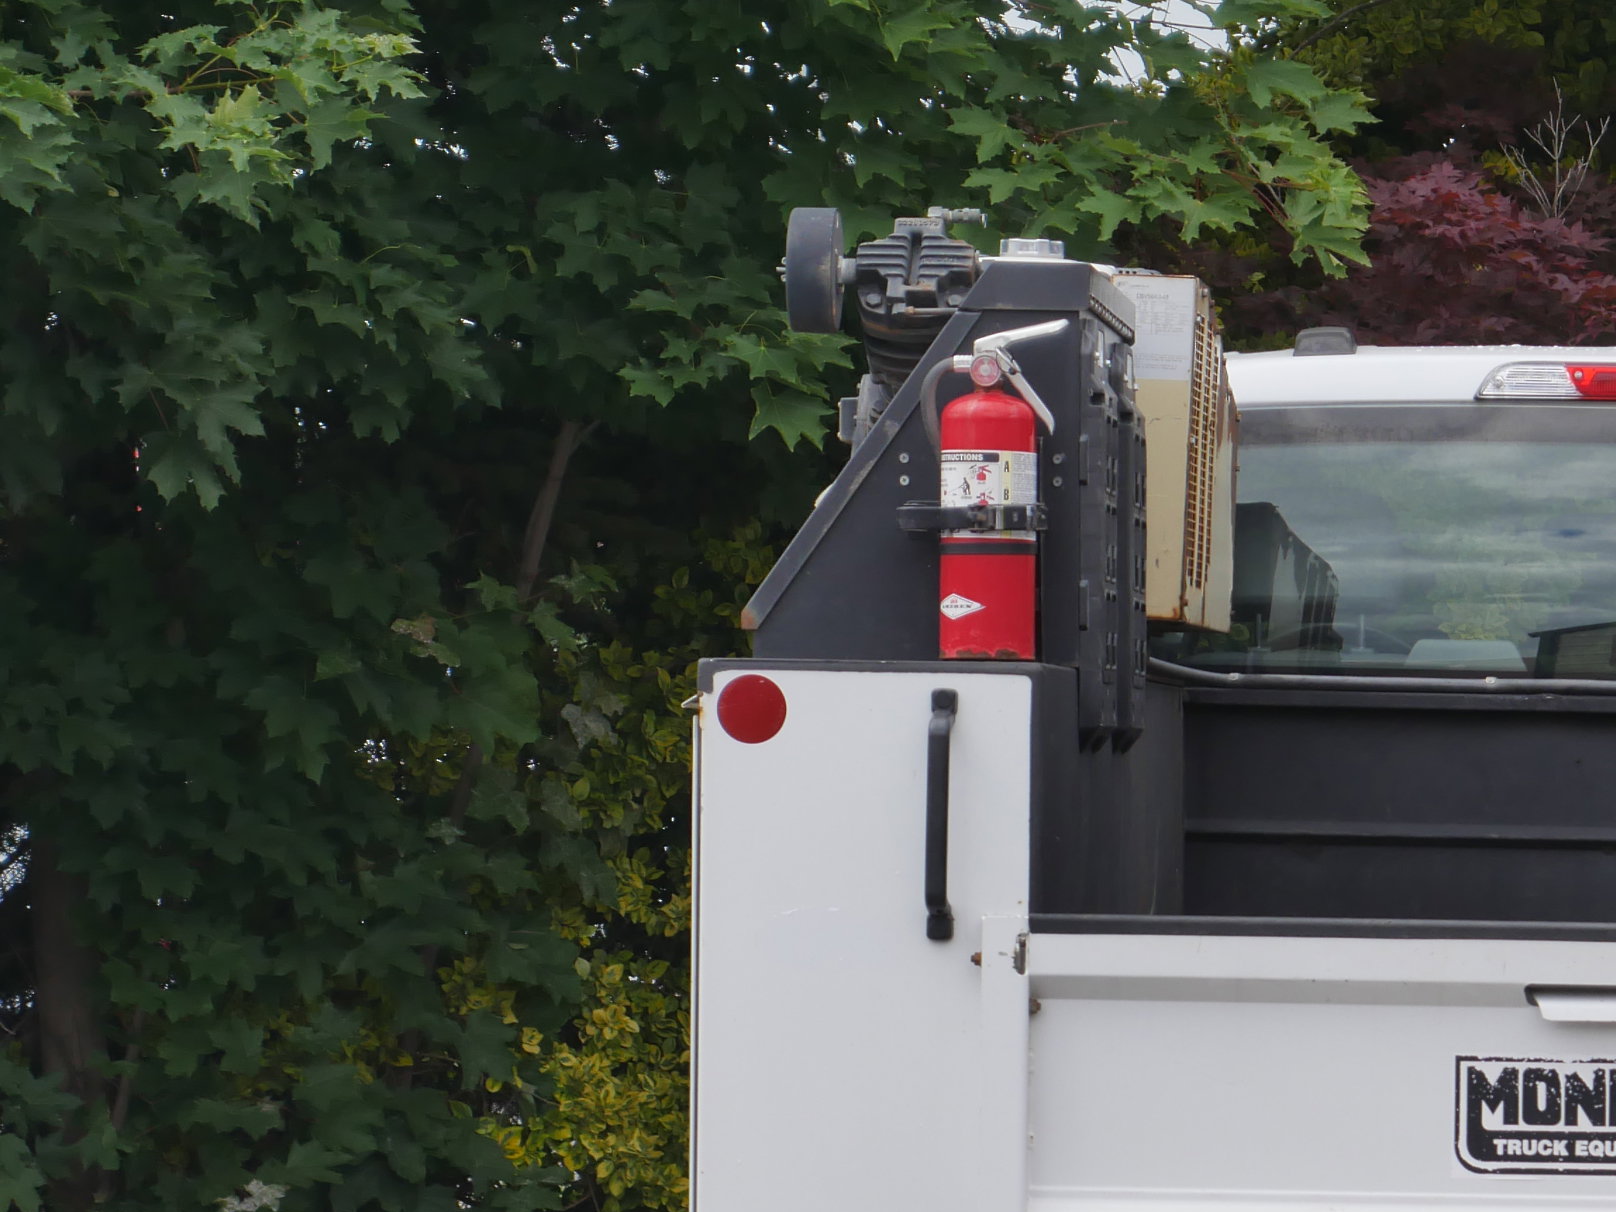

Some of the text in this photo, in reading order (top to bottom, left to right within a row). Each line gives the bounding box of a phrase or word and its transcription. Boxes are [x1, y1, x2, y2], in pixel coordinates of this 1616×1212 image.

[1004, 461, 1010, 473] A
[1003, 489, 1010, 501] B
[1493, 1138, 1569, 1157] TRUCK
